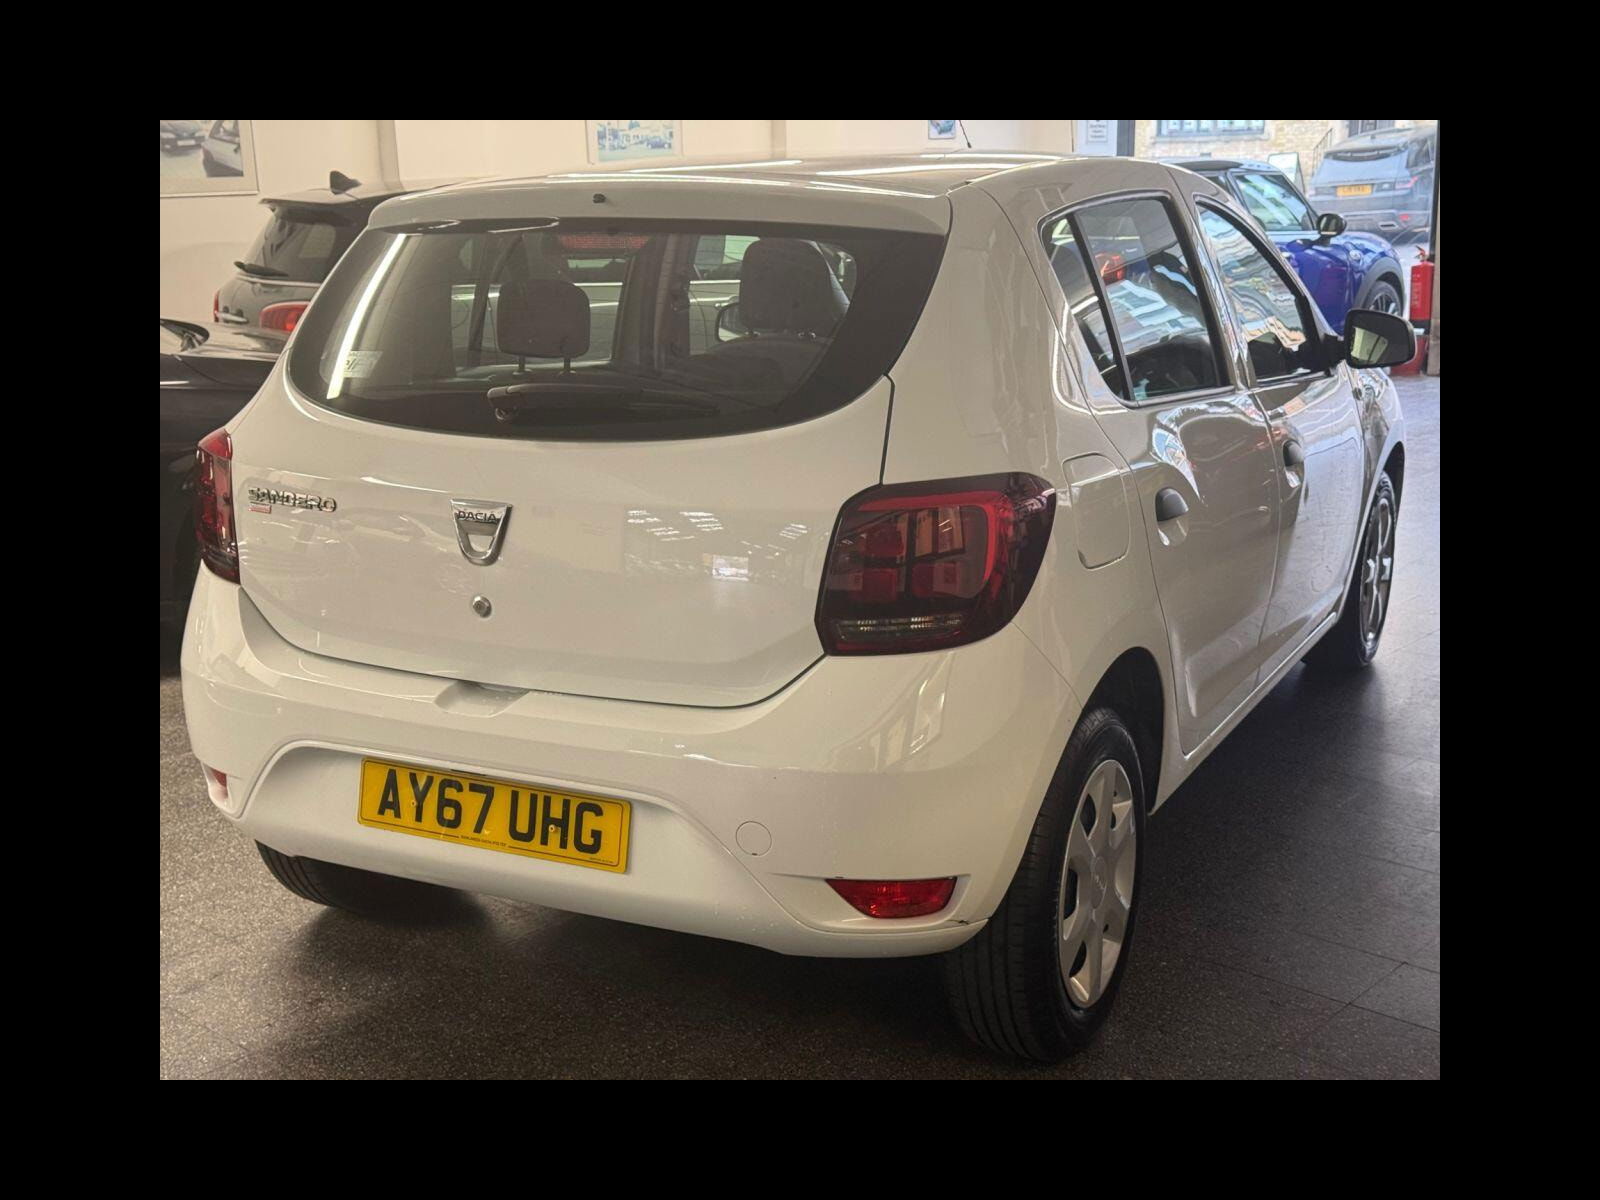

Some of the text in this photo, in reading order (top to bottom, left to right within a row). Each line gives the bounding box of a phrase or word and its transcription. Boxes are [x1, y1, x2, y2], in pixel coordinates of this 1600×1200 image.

[457, 510, 497, 522] DACIA
[377, 768, 604, 854] AY67 UHG
